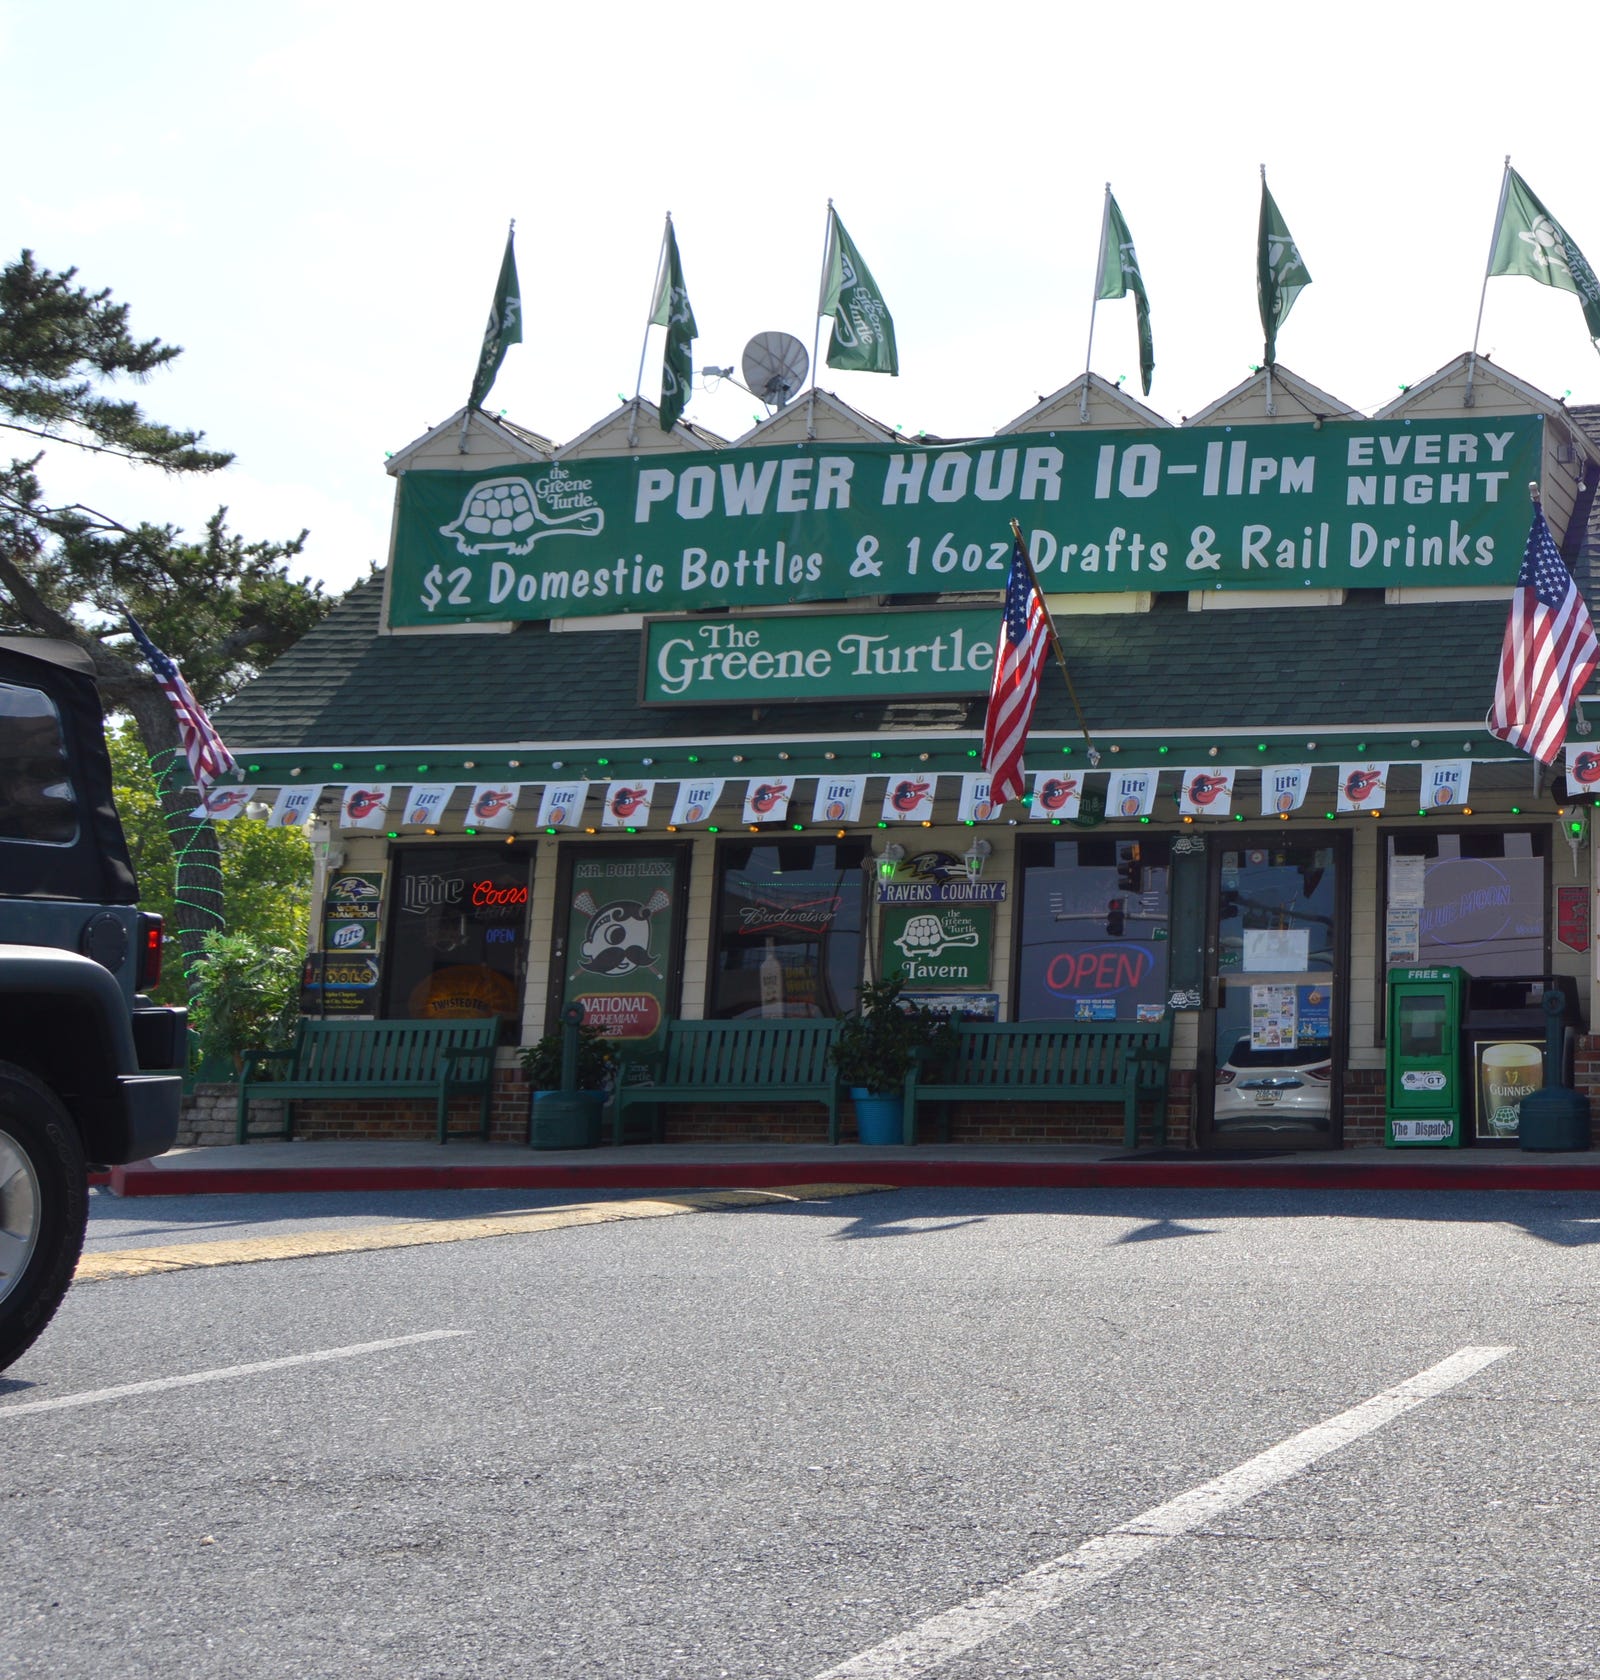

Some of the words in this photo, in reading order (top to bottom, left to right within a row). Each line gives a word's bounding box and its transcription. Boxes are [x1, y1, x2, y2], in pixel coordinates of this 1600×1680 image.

[1347, 432, 1515, 466] EVERY
[549, 466, 569, 481] the
[535, 477, 593, 498] Greene
[634, 456, 855, 523] POWER
[882, 447, 1064, 505] HOUR
[1347, 471, 1509, 505] NIGHT
[421, 565, 472, 612] $2
[489, 554, 663, 604] Domestic
[681, 542, 822, 590] Bottles
[850, 536, 883, 578] &
[908, 532, 1011, 575] 16oz
[1029, 526, 1168, 575] Drafts
[1186, 525, 1221, 571] &
[1242, 523, 1328, 570] Rail
[1350, 520, 1495, 568] Drinks
[699, 624, 760, 650] The
[657, 637, 831, 695] Greene
[838, 627, 994, 677] Turtle
[1273, 775, 1297, 791] Lite
[1434, 771, 1459, 786] Lite
[827, 785, 853, 800] Lite
[1120, 781, 1146, 795] Lite
[285, 794, 309, 808] Lite
[415, 792, 441, 807] Lite
[551, 791, 574, 806] Lite
[688, 789, 712, 804] Lite
[606, 863, 635, 878] BOH
[638, 862, 672, 877] LAX
[402, 875, 464, 914] Lite
[472, 880, 528, 906] Coors
[887, 885, 933, 901] RAVENS
[941, 884, 998, 900] COUNTRY
[1460, 885, 1512, 918] MOON
[739, 907, 838, 925] Budweiser
[947, 909, 960, 917] the
[941, 916, 972, 928] Greene
[948, 925, 977, 933] Turtle
[486, 929, 515, 943] OPEN
[902, 961, 968, 979] Tavern
[1046, 953, 1144, 989] OPEN
[1408, 970, 1439, 979] FREE
[581, 997, 648, 1012] NATIONAL
[1489, 1083, 1536, 1097] GUINNESS
[1393, 1122, 1409, 1136] The
[1415, 1122, 1451, 1136] Dispatch
